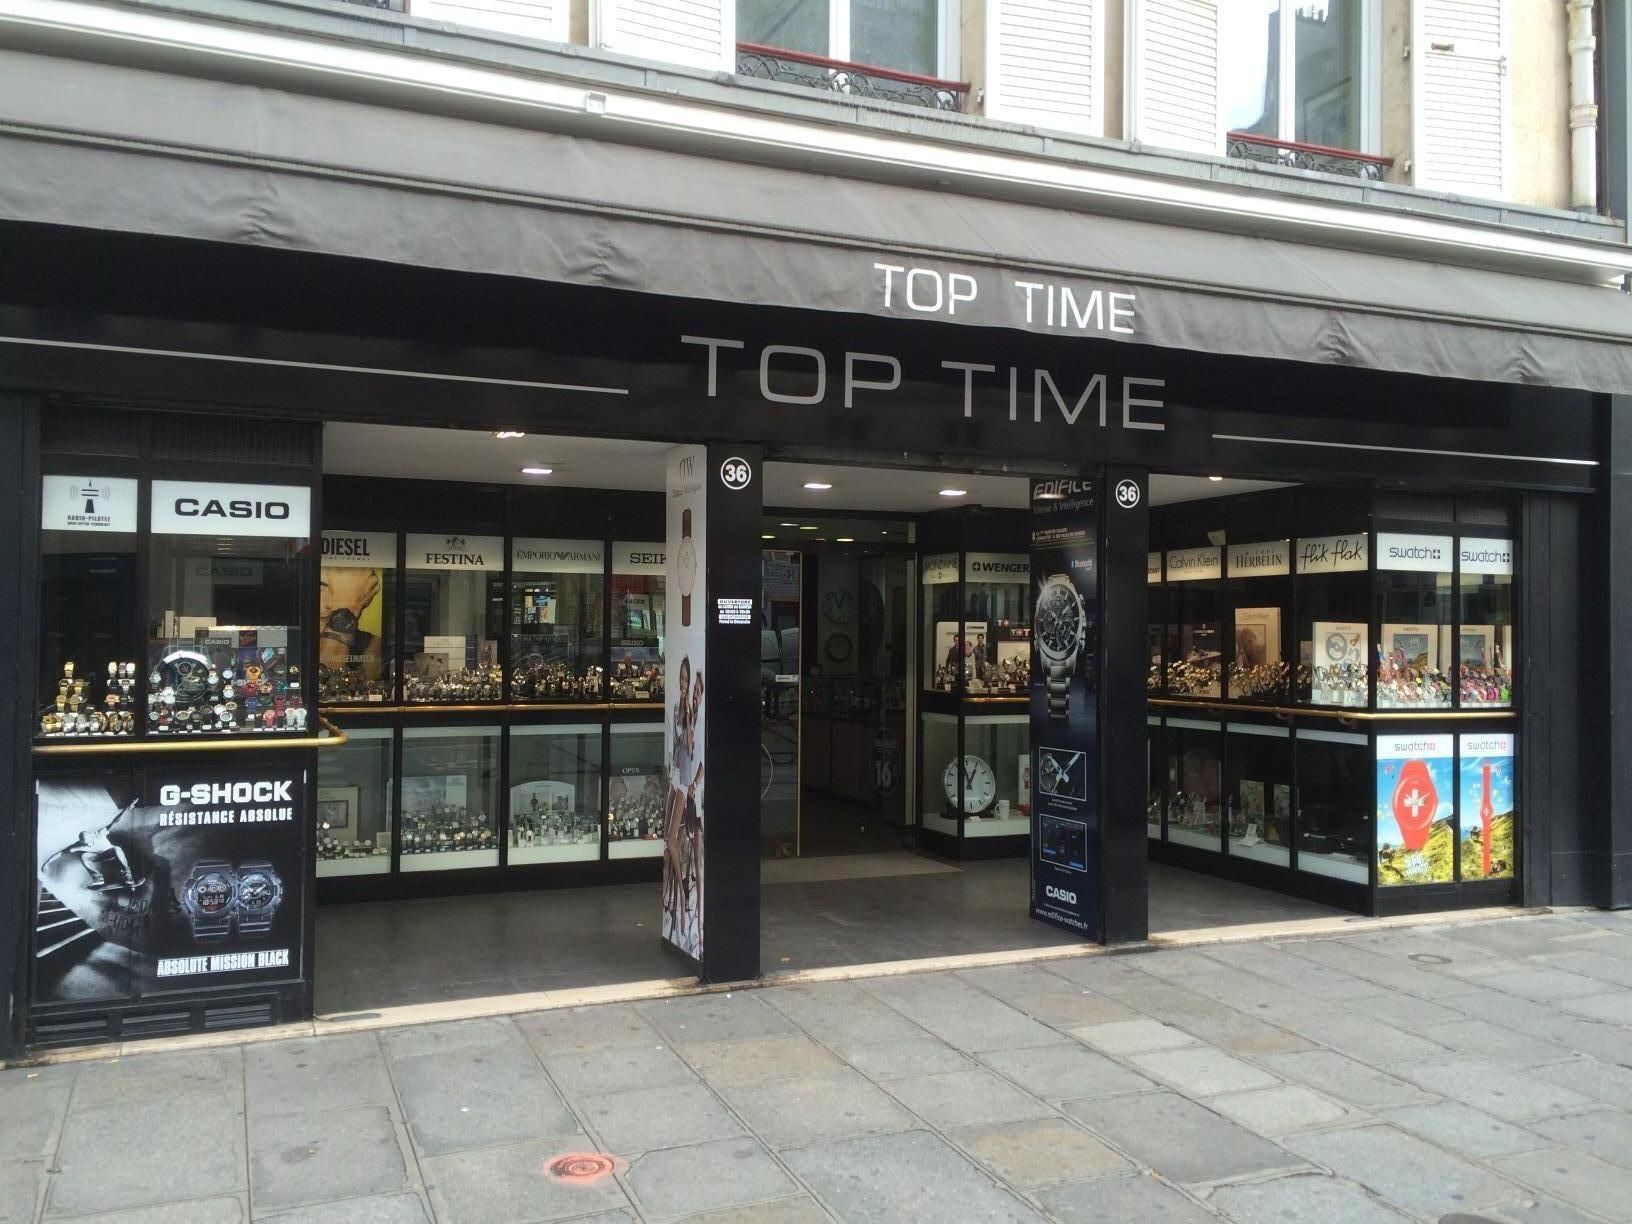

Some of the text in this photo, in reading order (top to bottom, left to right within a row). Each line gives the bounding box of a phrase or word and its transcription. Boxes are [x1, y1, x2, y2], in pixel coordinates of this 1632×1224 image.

[874, 262, 1136, 335] TOP TIME
[681, 335, 1166, 431] TOP TIME
[725, 464, 747, 482] 36
[1119, 486, 1136, 502] 36
[174, 498, 290, 520] CASIO
[320, 537, 370, 556] DIESEL
[1300, 540, 1363, 569] flik flak
[1389, 547, 1432, 560] swatch
[425, 553, 485, 566] FESTINA
[516, 551, 600, 561] EMPORIO ARMANI
[1169, 550, 1219, 569] Calvin Klein
[1236, 554, 1283, 568] HERBELIN
[1461, 550, 1501, 563] swatch
[982, 562, 1030, 573] WENGER
[1394, 742, 1430, 751] swatch
[1467, 740, 1502, 751] swatch
[160, 781, 292, 806] G-SHOCK
[160, 807, 293, 826] RÉSISTANCE ABSOLUE
[1045, 885, 1077, 904] CASIO
[157, 949, 289, 976] ABSOLUTE MISSION BLACK
